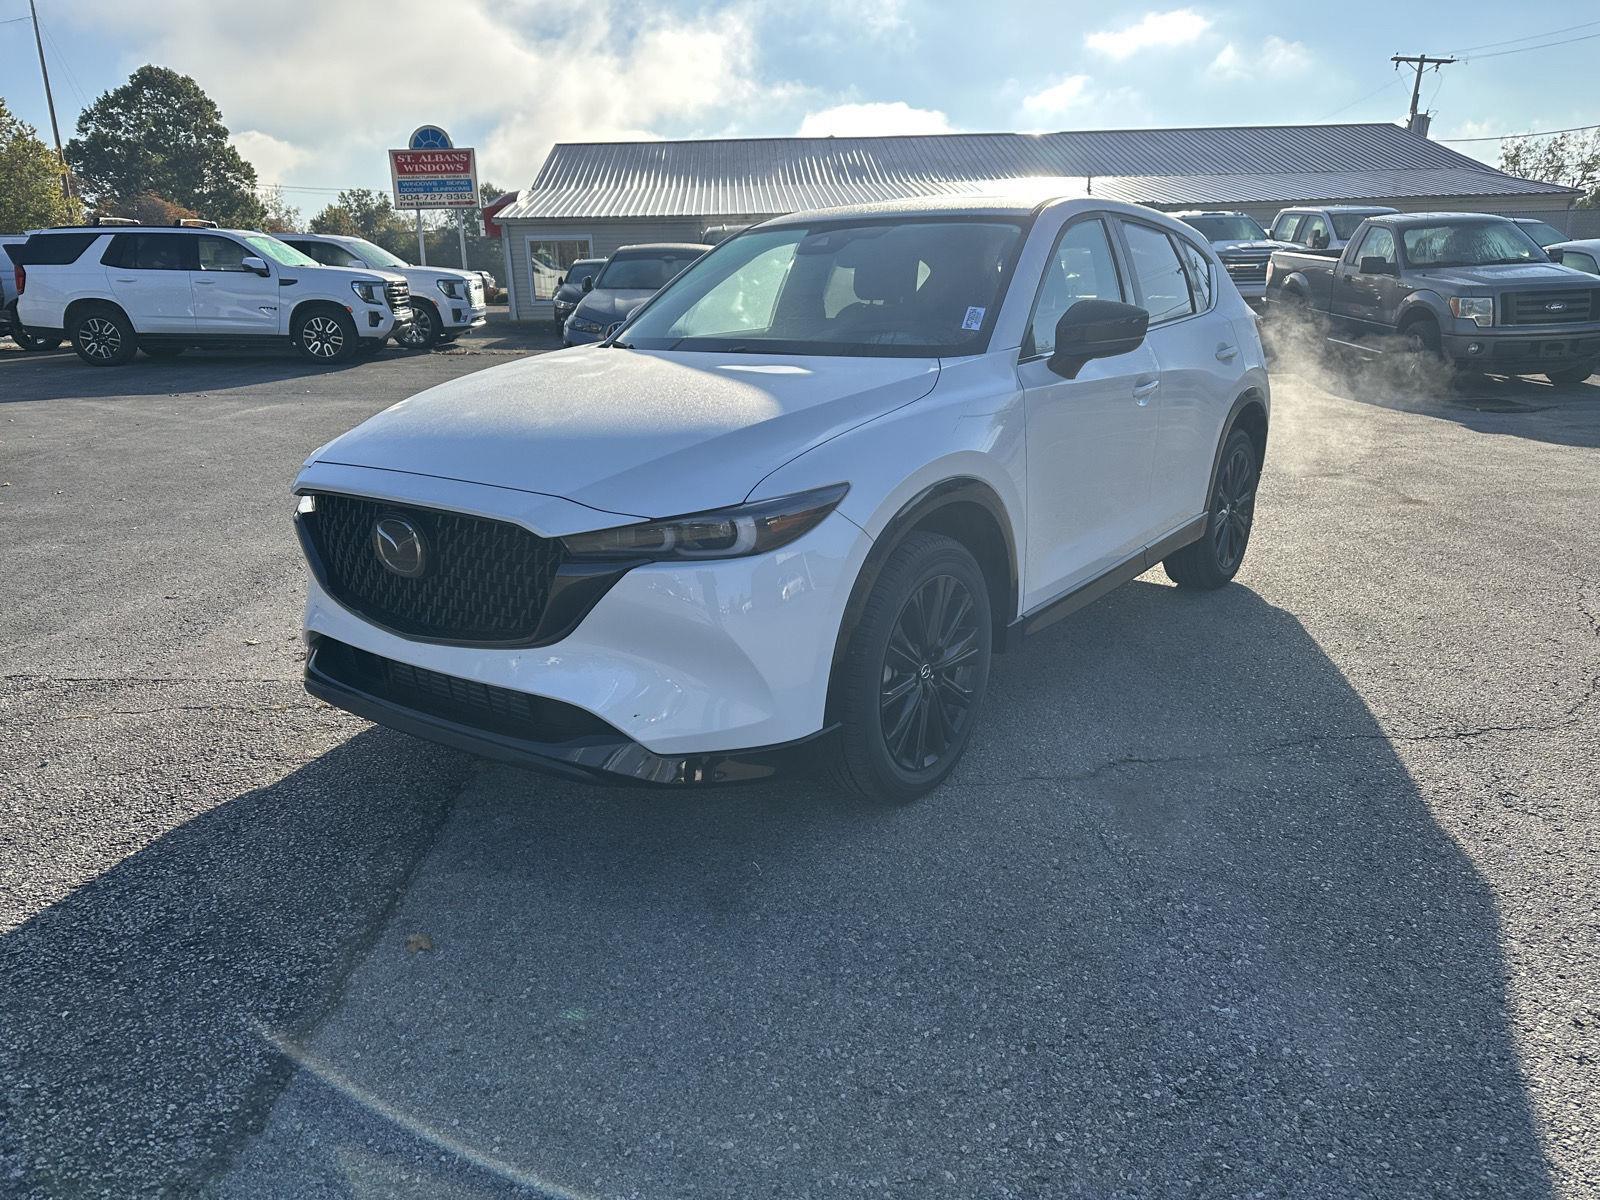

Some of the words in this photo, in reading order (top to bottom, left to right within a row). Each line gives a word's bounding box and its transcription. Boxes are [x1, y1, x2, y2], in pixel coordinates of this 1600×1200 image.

[397, 154, 415, 162] ST.
[419, 153, 468, 162] ALBANS
[403, 163, 464, 172] WINDOWS
[399, 193, 474, 201] 304-727-9363
